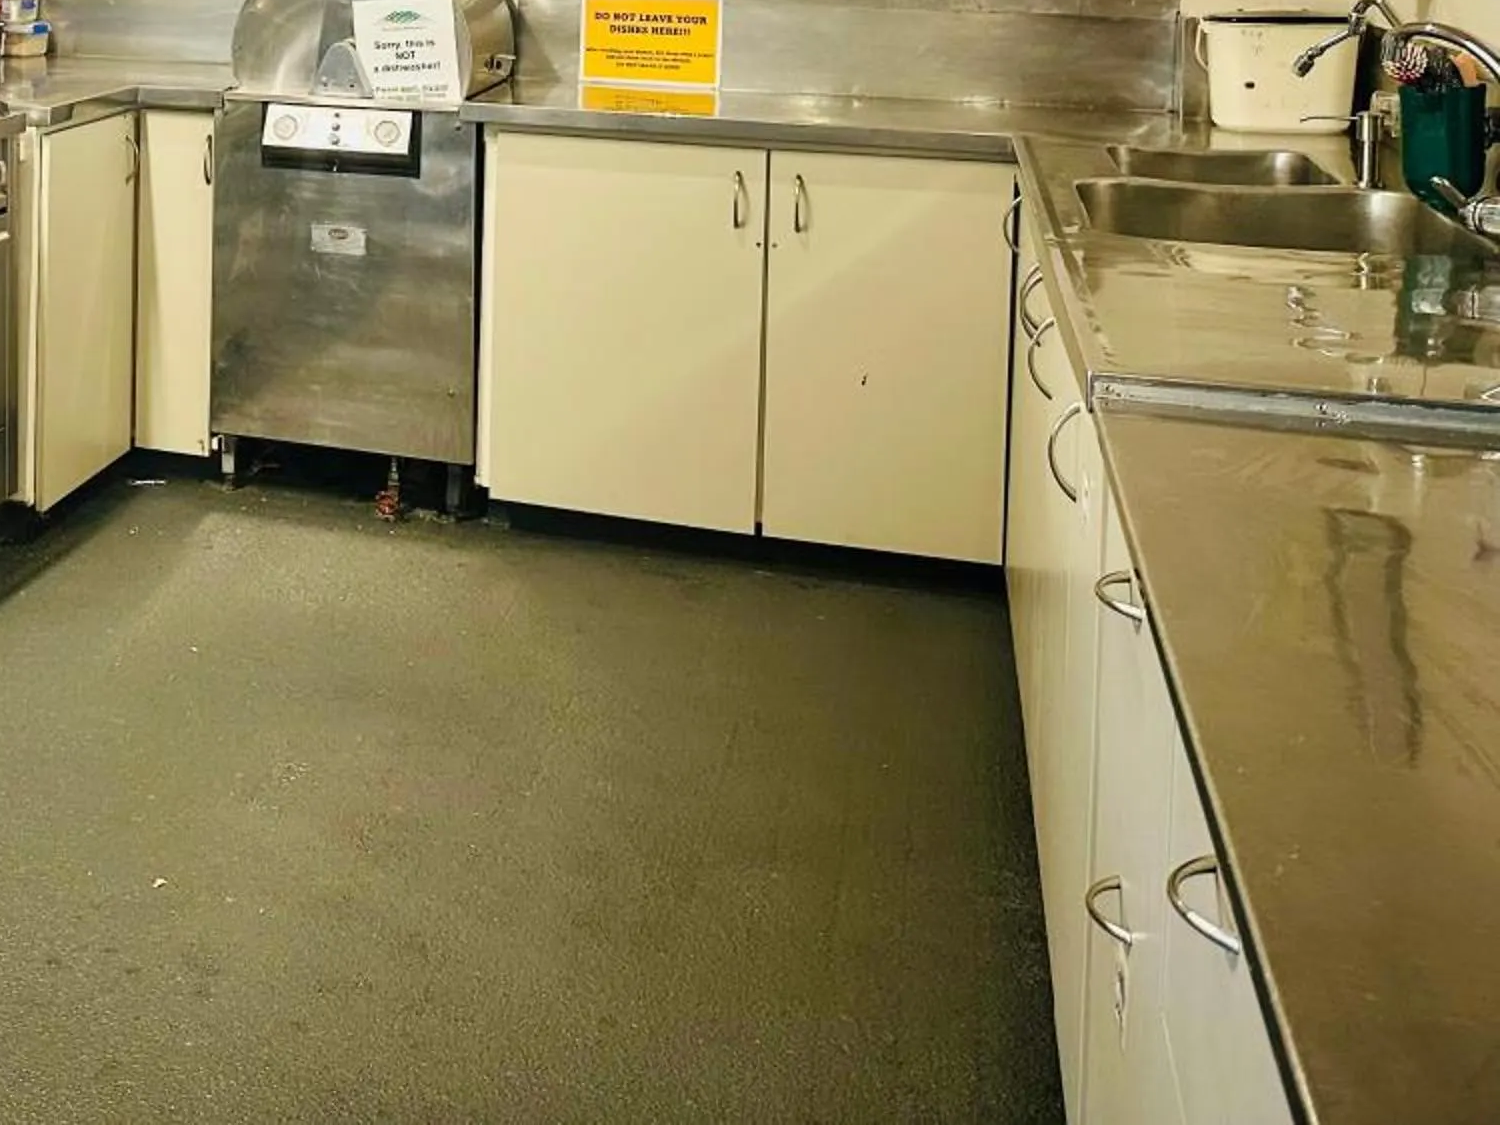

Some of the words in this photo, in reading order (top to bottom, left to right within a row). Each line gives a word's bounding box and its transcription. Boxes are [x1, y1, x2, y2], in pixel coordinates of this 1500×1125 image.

[595, 12, 610, 20] DO
[613, 12, 636, 22] NOT
[639, 14, 673, 24] LEAVE
[676, 15, 707, 25] YOUR
[395, 50, 415, 60] NOT
